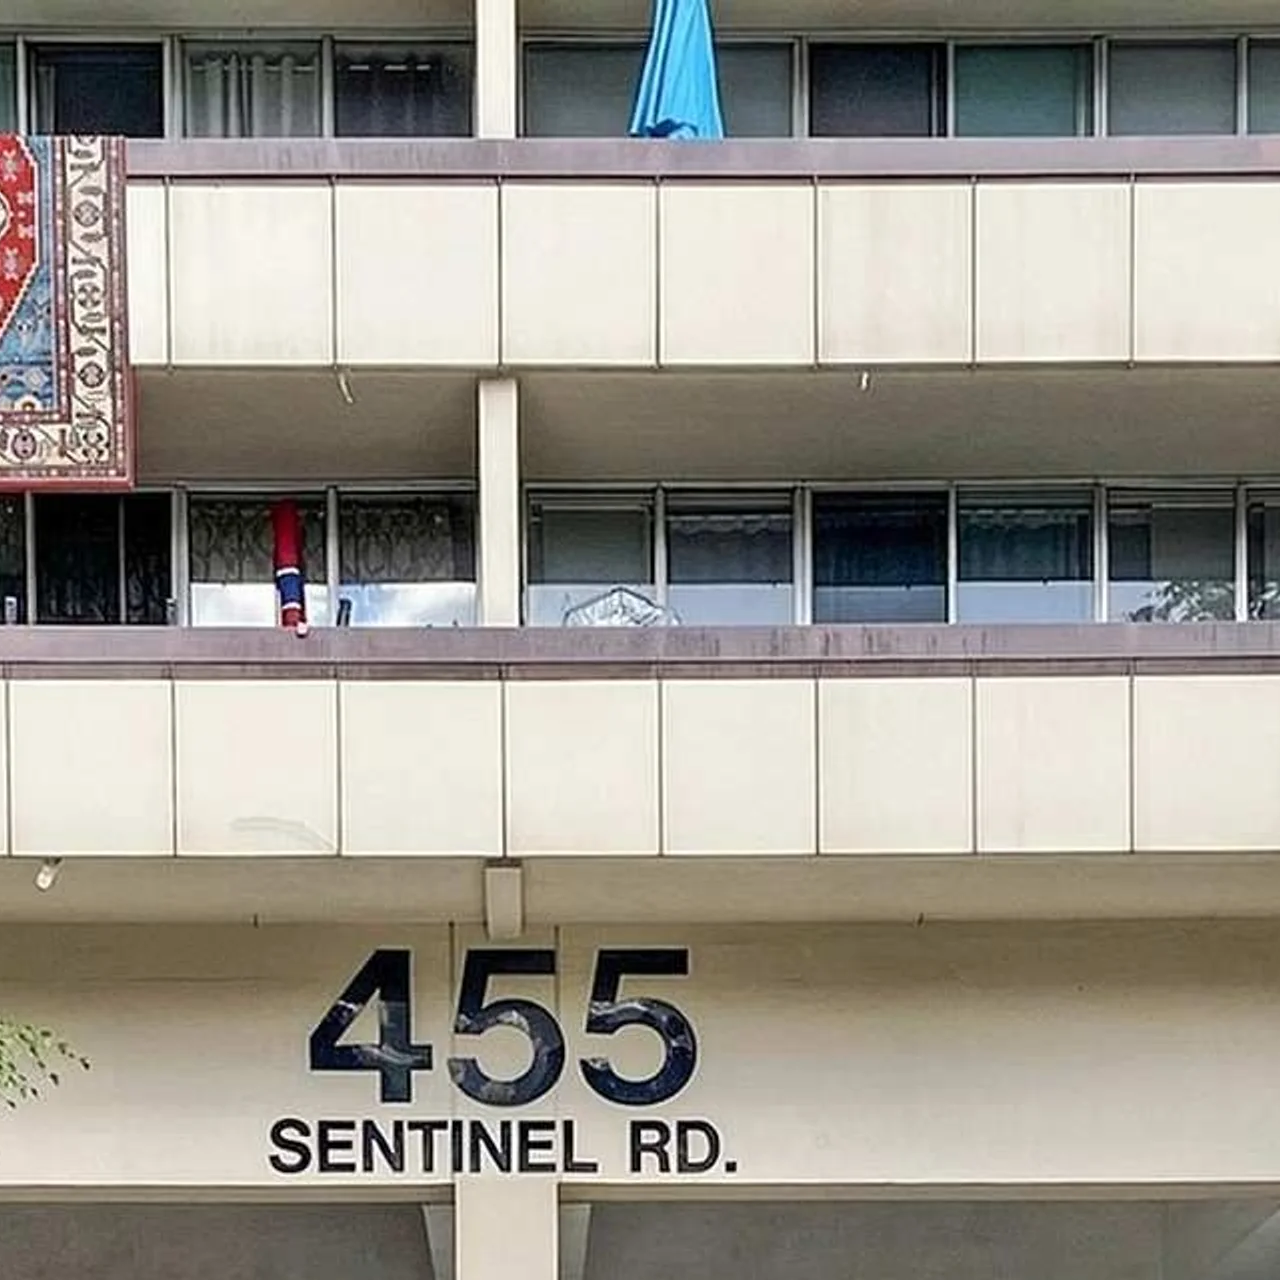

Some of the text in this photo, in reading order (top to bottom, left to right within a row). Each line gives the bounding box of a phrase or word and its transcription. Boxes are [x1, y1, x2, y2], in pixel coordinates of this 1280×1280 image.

[309, 947, 699, 1105] 455
[268, 1117, 738, 1174] SENTINEL RD.
